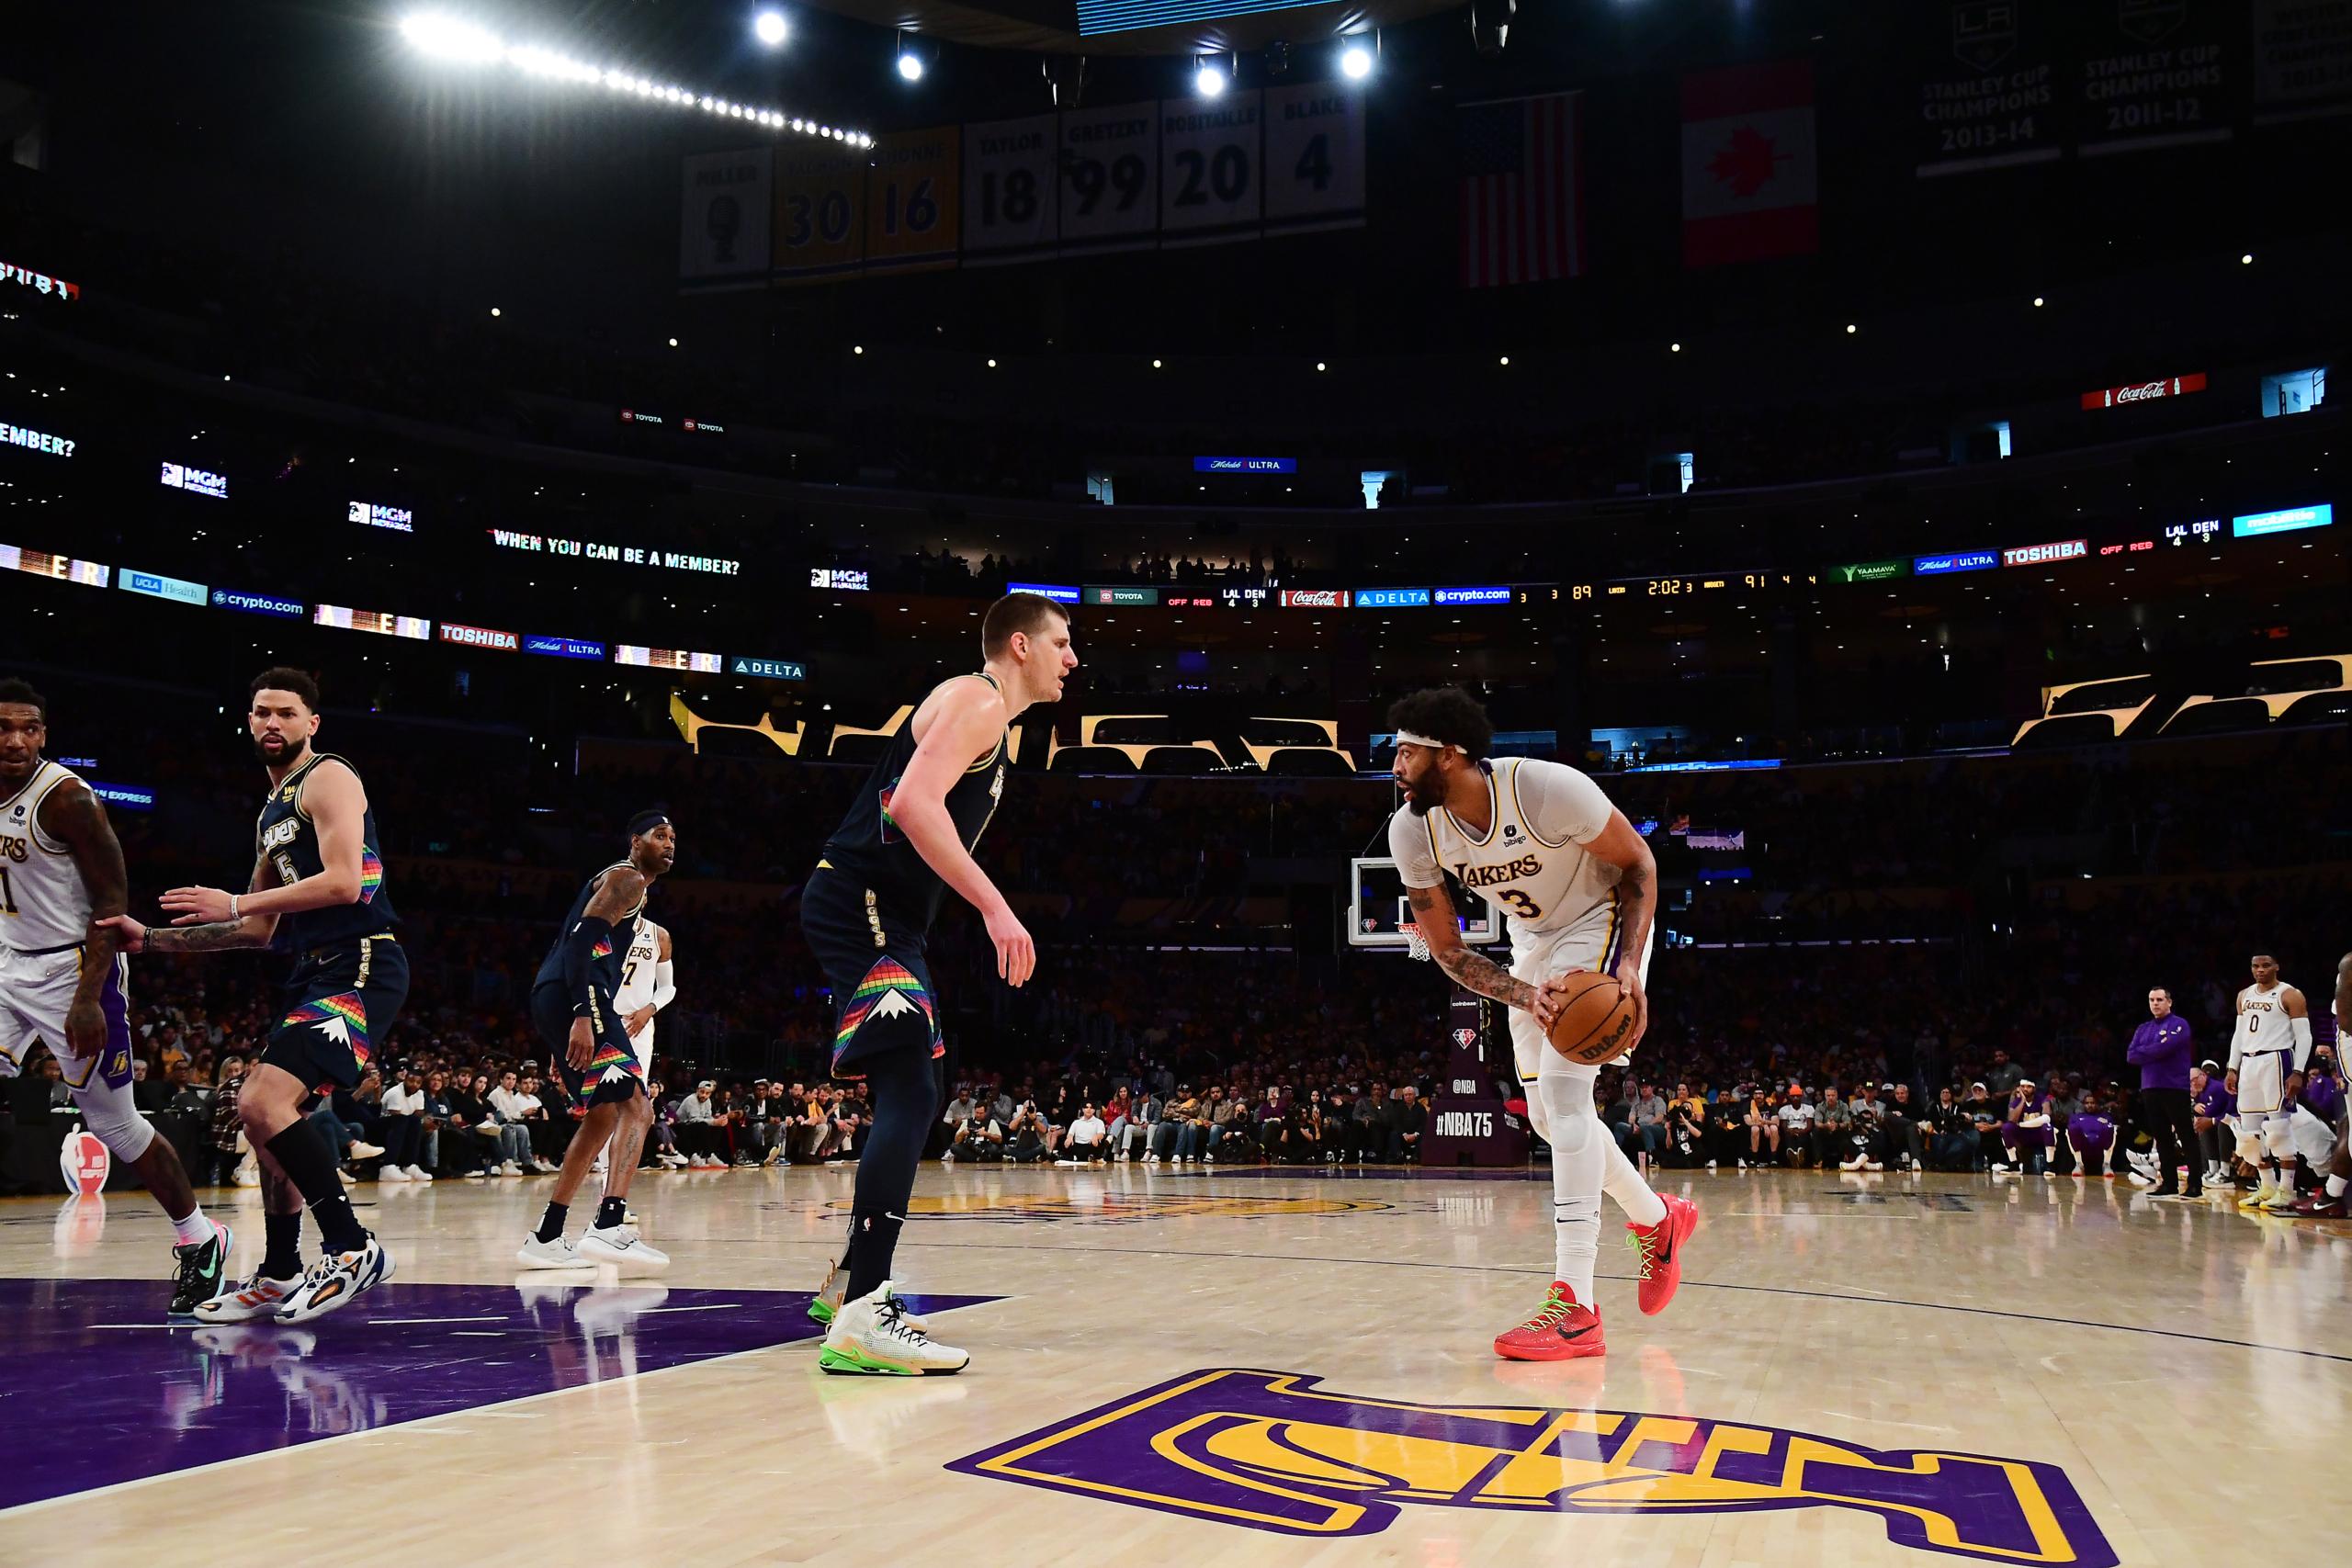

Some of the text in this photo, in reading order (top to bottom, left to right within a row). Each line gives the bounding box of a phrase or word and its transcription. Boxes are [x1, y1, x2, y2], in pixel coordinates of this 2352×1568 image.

[2085, 44, 2222, 78] STANLEY CUP
[1922, 64, 2051, 100] STANLEY CUP
[2085, 65, 2222, 101] CHAMPIONS
[1922, 85, 2052, 121] CHAMPIONS
[2107, 97, 2201, 130] 2011-12
[1068, 118, 1148, 143] GRETZKY
[1940, 117, 2035, 152] 2013-14
[1295, 135, 1331, 192] 4
[1071, 153, 1148, 216] 99
[1173, 144, 1250, 208] 20
[885, 177, 938, 235] 16
[980, 169, 1037, 229] 18
[786, 189, 853, 247] 30
[635, 413, 662, 423] TOYOTA
[697, 423, 723, 433] TOYOTA
[1249, 461, 1280, 469] ULTRA
[371, 504, 412, 524] MGM
[2165, 519, 2219, 537] LAL DEN
[2173, 532, 2211, 547] 4 3
[493, 528, 741, 575] WHEN YOU CAN BE A MEMBER?
[2004, 541, 2086, 565] TOSHIBA
[2100, 541, 2154, 556] OFF REB
[1959, 556, 1995, 567] ULTRA
[831, 570, 868, 582] MGM
[1782, 575, 1790, 584] 4
[1808, 575, 1815, 584] 4
[135, 577, 198, 599] UCLA Health
[1223, 589, 1266, 599] LAL DEN
[1375, 592, 1429, 604] DELTA
[1447, 590, 1510, 601] crypto.com
[1573, 585, 1591, 600] 89
[1648, 580, 1679, 595] 2:02
[1686, 582, 1692, 592] 3
[228, 594, 303, 615] crypto.com
[1227, 599, 1259, 607] 4 3
[441, 625, 517, 649] TOSHIBA
[568, 644, 602, 656] ULTRA
[752, 661, 802, 677] DELTA
[0, 835, 28, 863] RS
[1503, 835, 1527, 848] bibigo
[1454, 853, 1543, 888] LAKERS
[0, 867, 18, 913] 1
[1498, 889, 1542, 919] 3
[624, 962, 638, 986] 7
[2249, 1014, 2259, 1033] 0
[1453, 1079, 1476, 1095] @NBA
[1435, 1111, 1493, 1138] #NBA75
